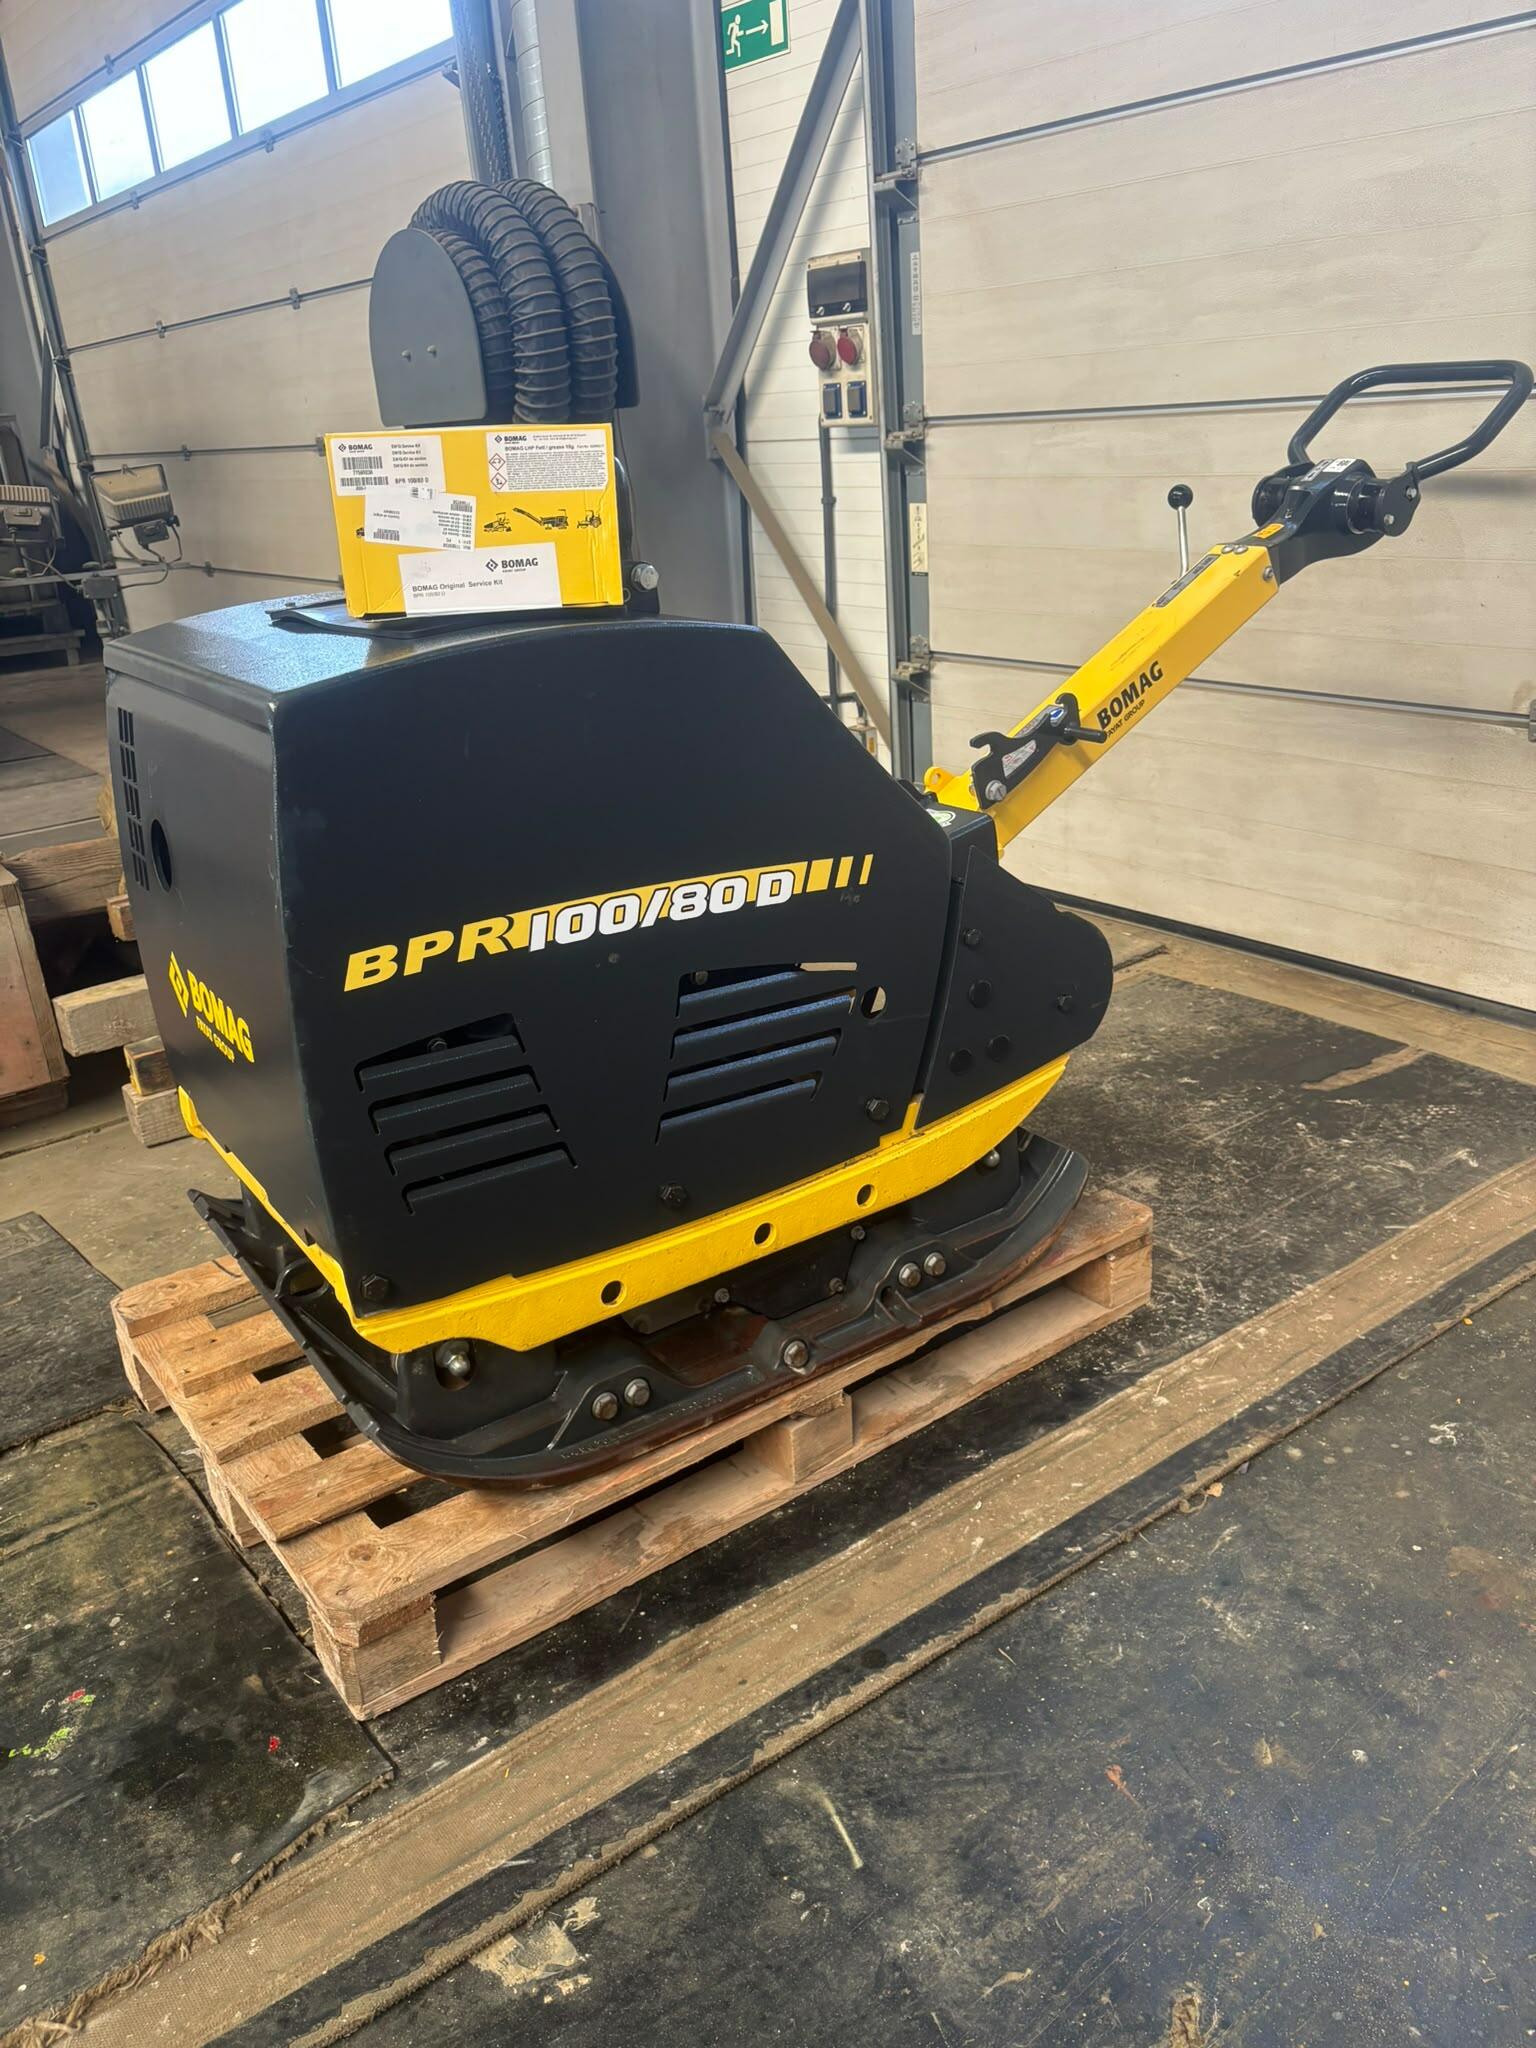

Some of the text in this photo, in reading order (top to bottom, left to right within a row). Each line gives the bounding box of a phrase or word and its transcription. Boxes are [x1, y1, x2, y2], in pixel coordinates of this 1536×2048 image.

[412, 584, 438, 592] BOMAG
[440, 582, 466, 590] Original
[468, 580, 492, 588] Service
[501, 557, 539, 569] BOMAG
[1097, 660, 1164, 730] BOMAG
[1124, 699, 1145, 721] GROUP
[344, 869, 796, 993] BPR 100/80 D
[187, 969, 255, 1063] BOMAG
